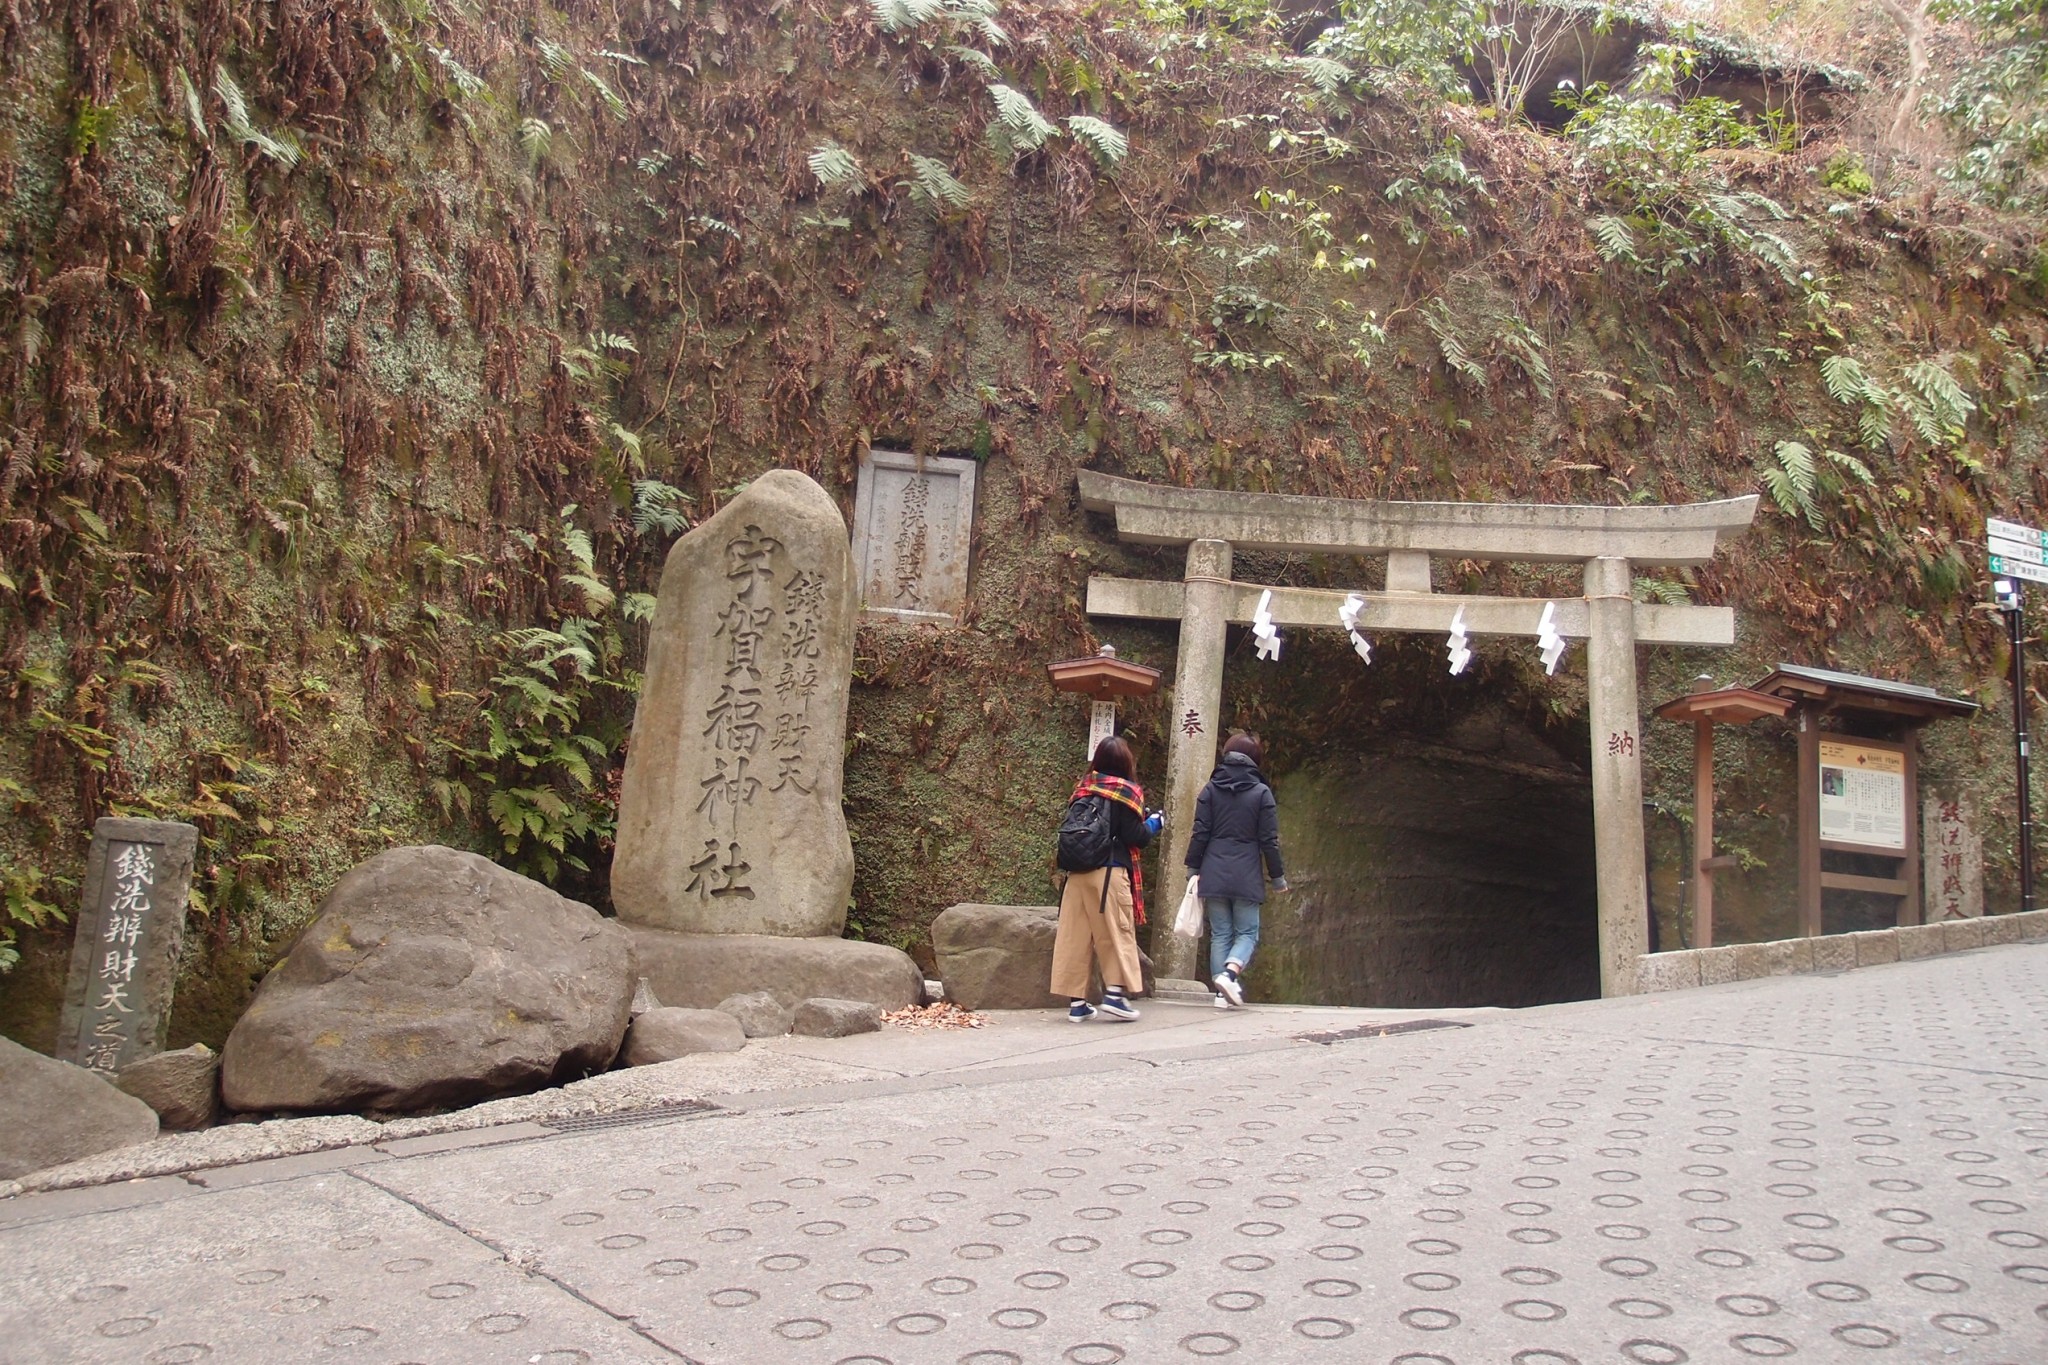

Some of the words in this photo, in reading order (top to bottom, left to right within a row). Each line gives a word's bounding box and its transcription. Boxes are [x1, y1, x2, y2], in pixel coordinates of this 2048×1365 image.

[684, 524, 785, 901] 宇賀福神社
[1180, 709, 1205, 739] 奉
[1608, 730, 1634, 757] 納
